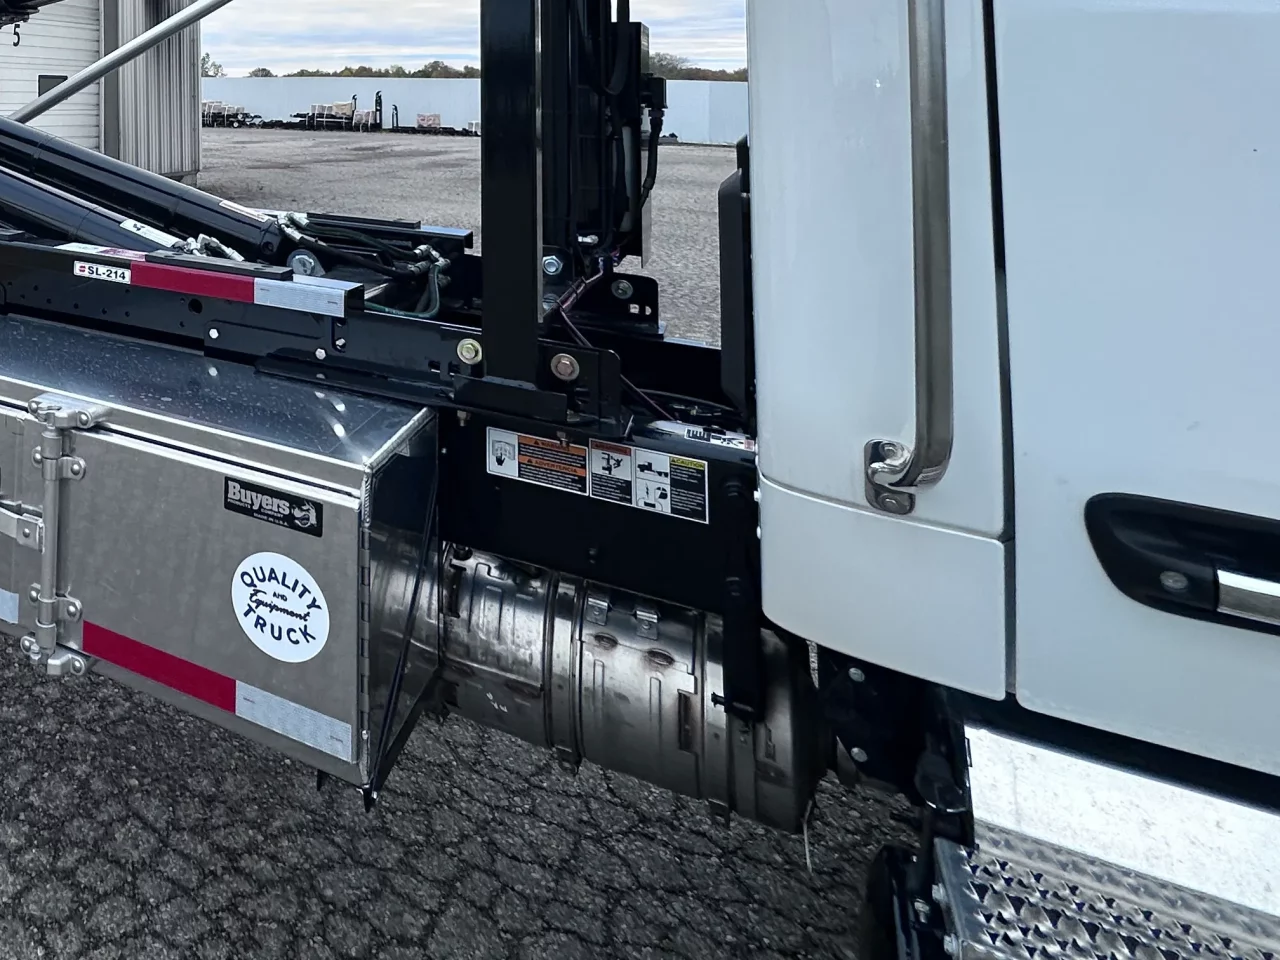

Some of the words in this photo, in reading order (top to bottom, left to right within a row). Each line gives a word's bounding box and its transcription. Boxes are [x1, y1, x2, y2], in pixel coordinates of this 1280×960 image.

[12, 23, 21, 47] 5
[87, 265, 126, 280] SL-214
[534, 460, 578, 474] ADVERTENCIA
[227, 480, 290, 515] Buyers
[227, 498, 251, 509] PRODUCTS
[253, 512, 268, 521] MADE
[260, 508, 284, 518] COMPANY
[240, 566, 322, 610] QUALITY
[272, 592, 288, 602] AND
[249, 589, 310, 622] Equipment
[243, 603, 316, 645] TRUCK
